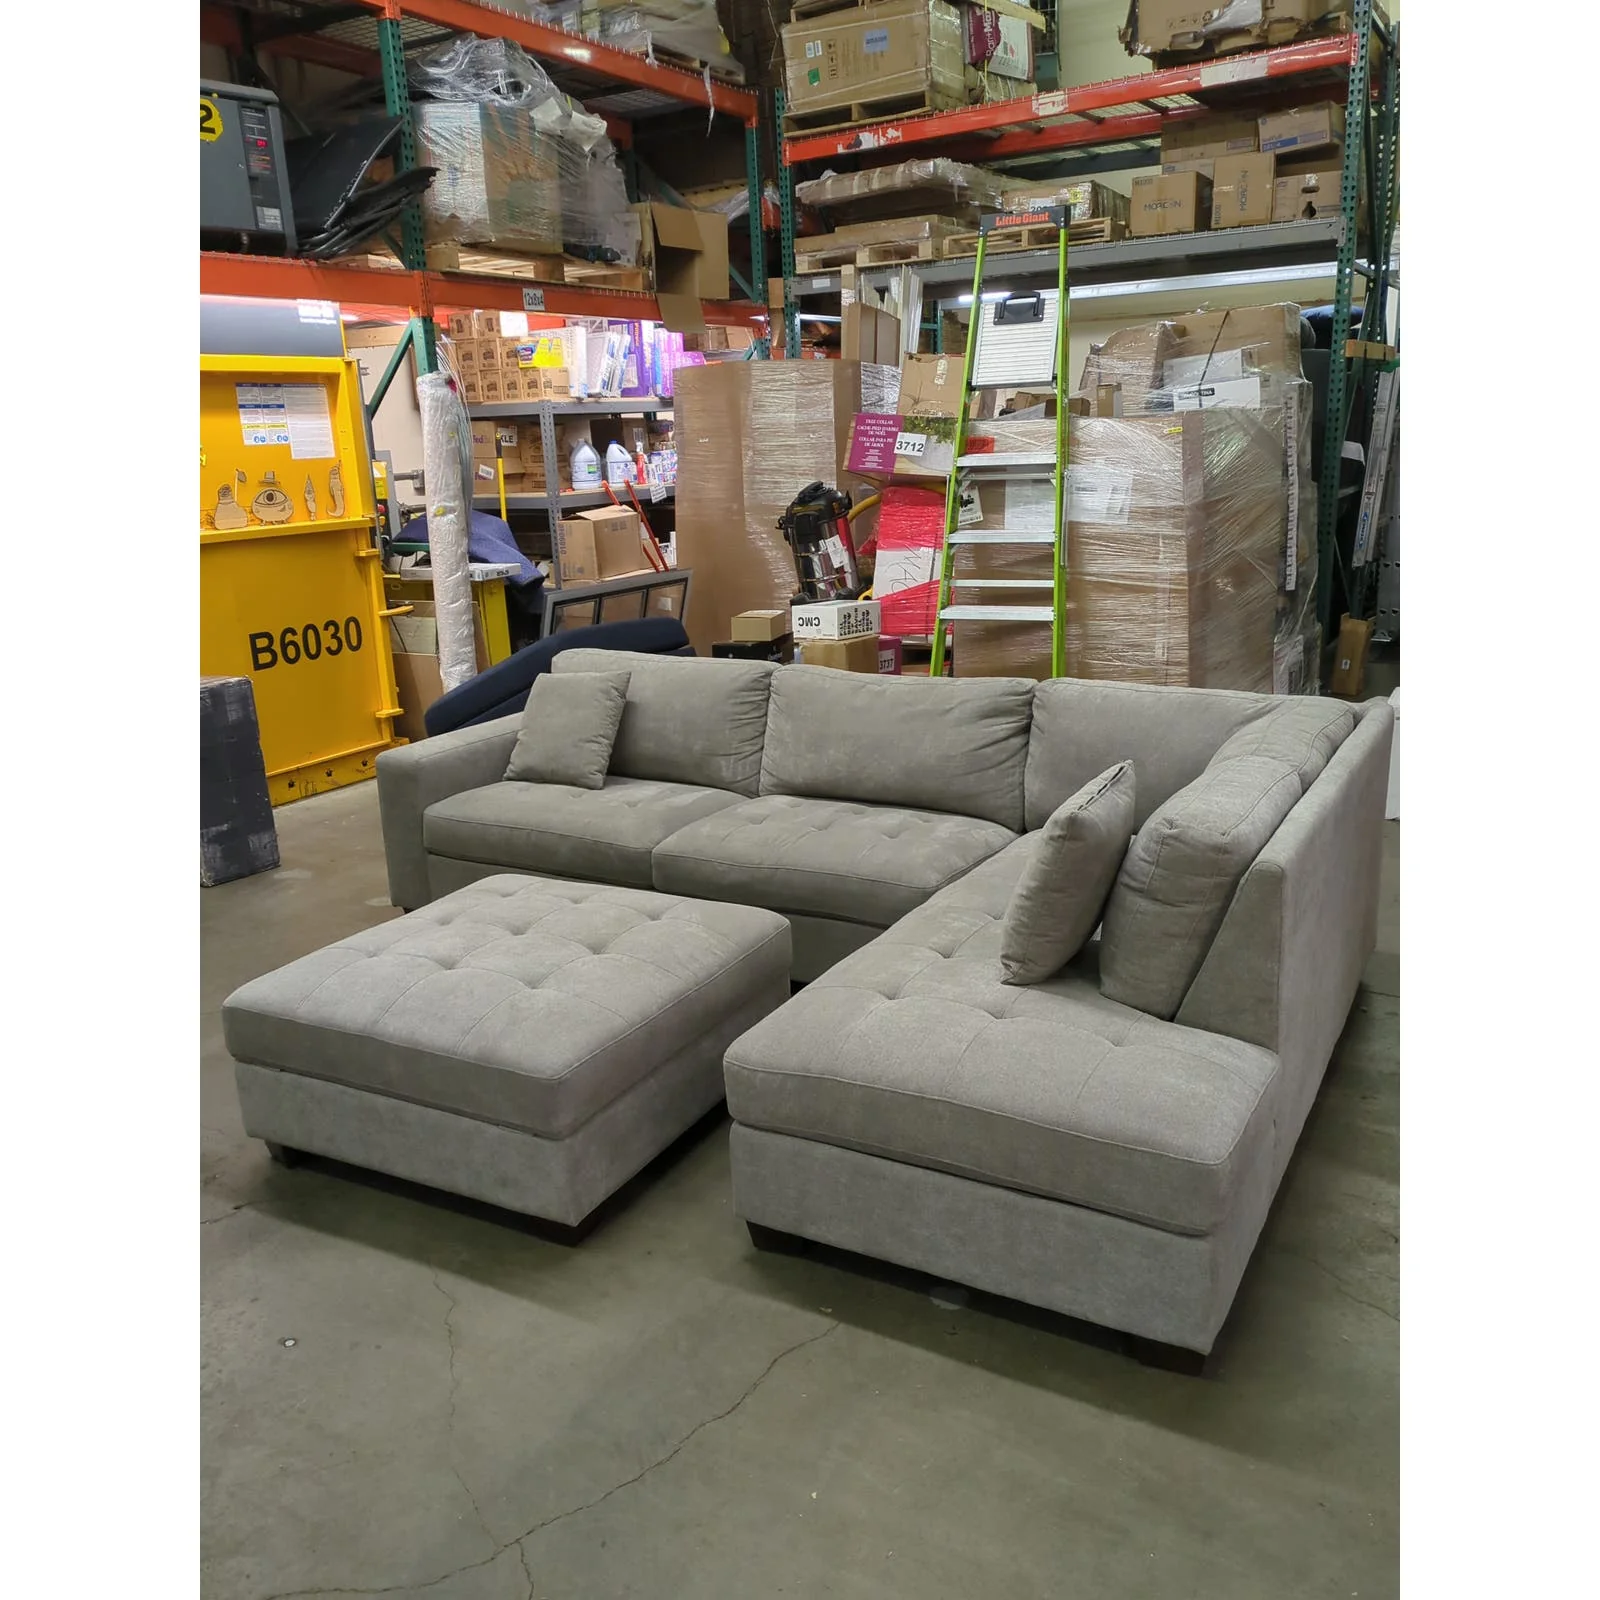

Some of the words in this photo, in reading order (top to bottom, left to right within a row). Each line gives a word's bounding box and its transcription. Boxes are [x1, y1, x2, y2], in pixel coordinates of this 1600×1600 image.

[995, 214, 1021, 226] Little
[1022, 212, 1049, 223] Giant
[896, 440, 924, 452] 3712
[798, 616, 821, 627] CMC
[248, 616, 362, 671] B6030
